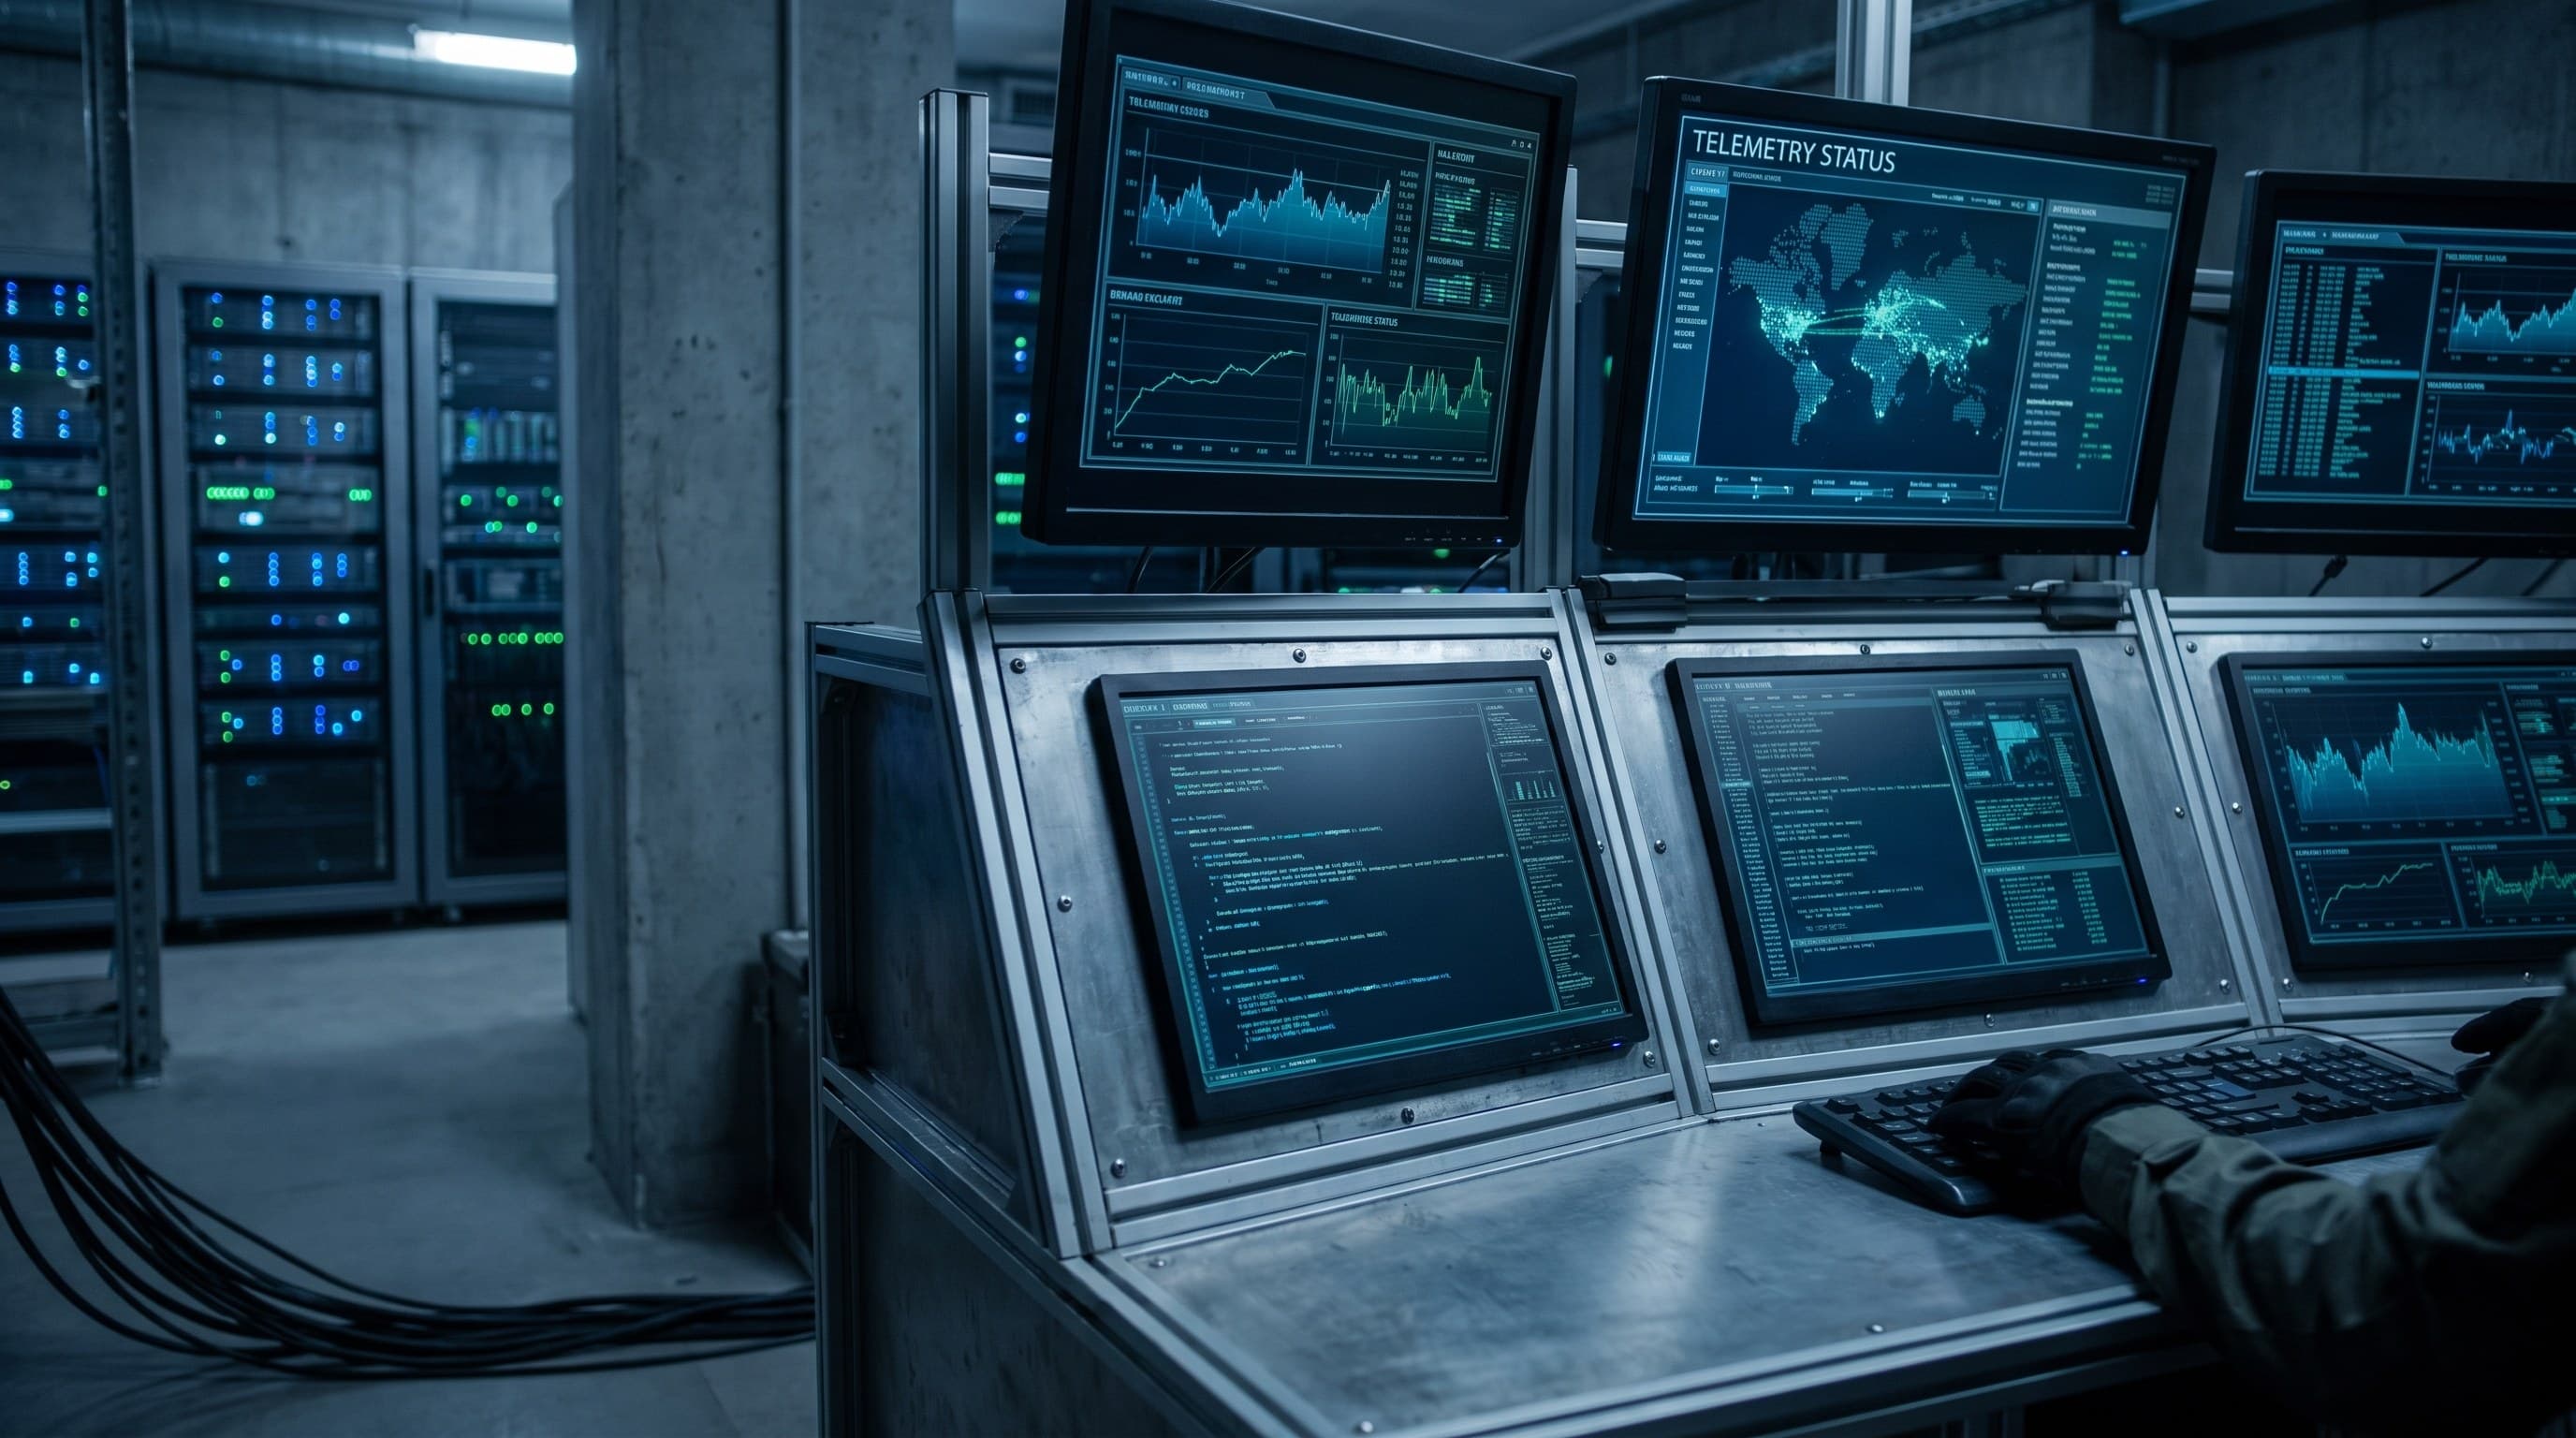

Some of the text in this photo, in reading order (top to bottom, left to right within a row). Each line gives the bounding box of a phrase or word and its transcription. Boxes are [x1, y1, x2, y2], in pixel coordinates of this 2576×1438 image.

[1692, 129, 1896, 173] TELEMETRY STATUS
[1373, 316, 1398, 328] STATUS
